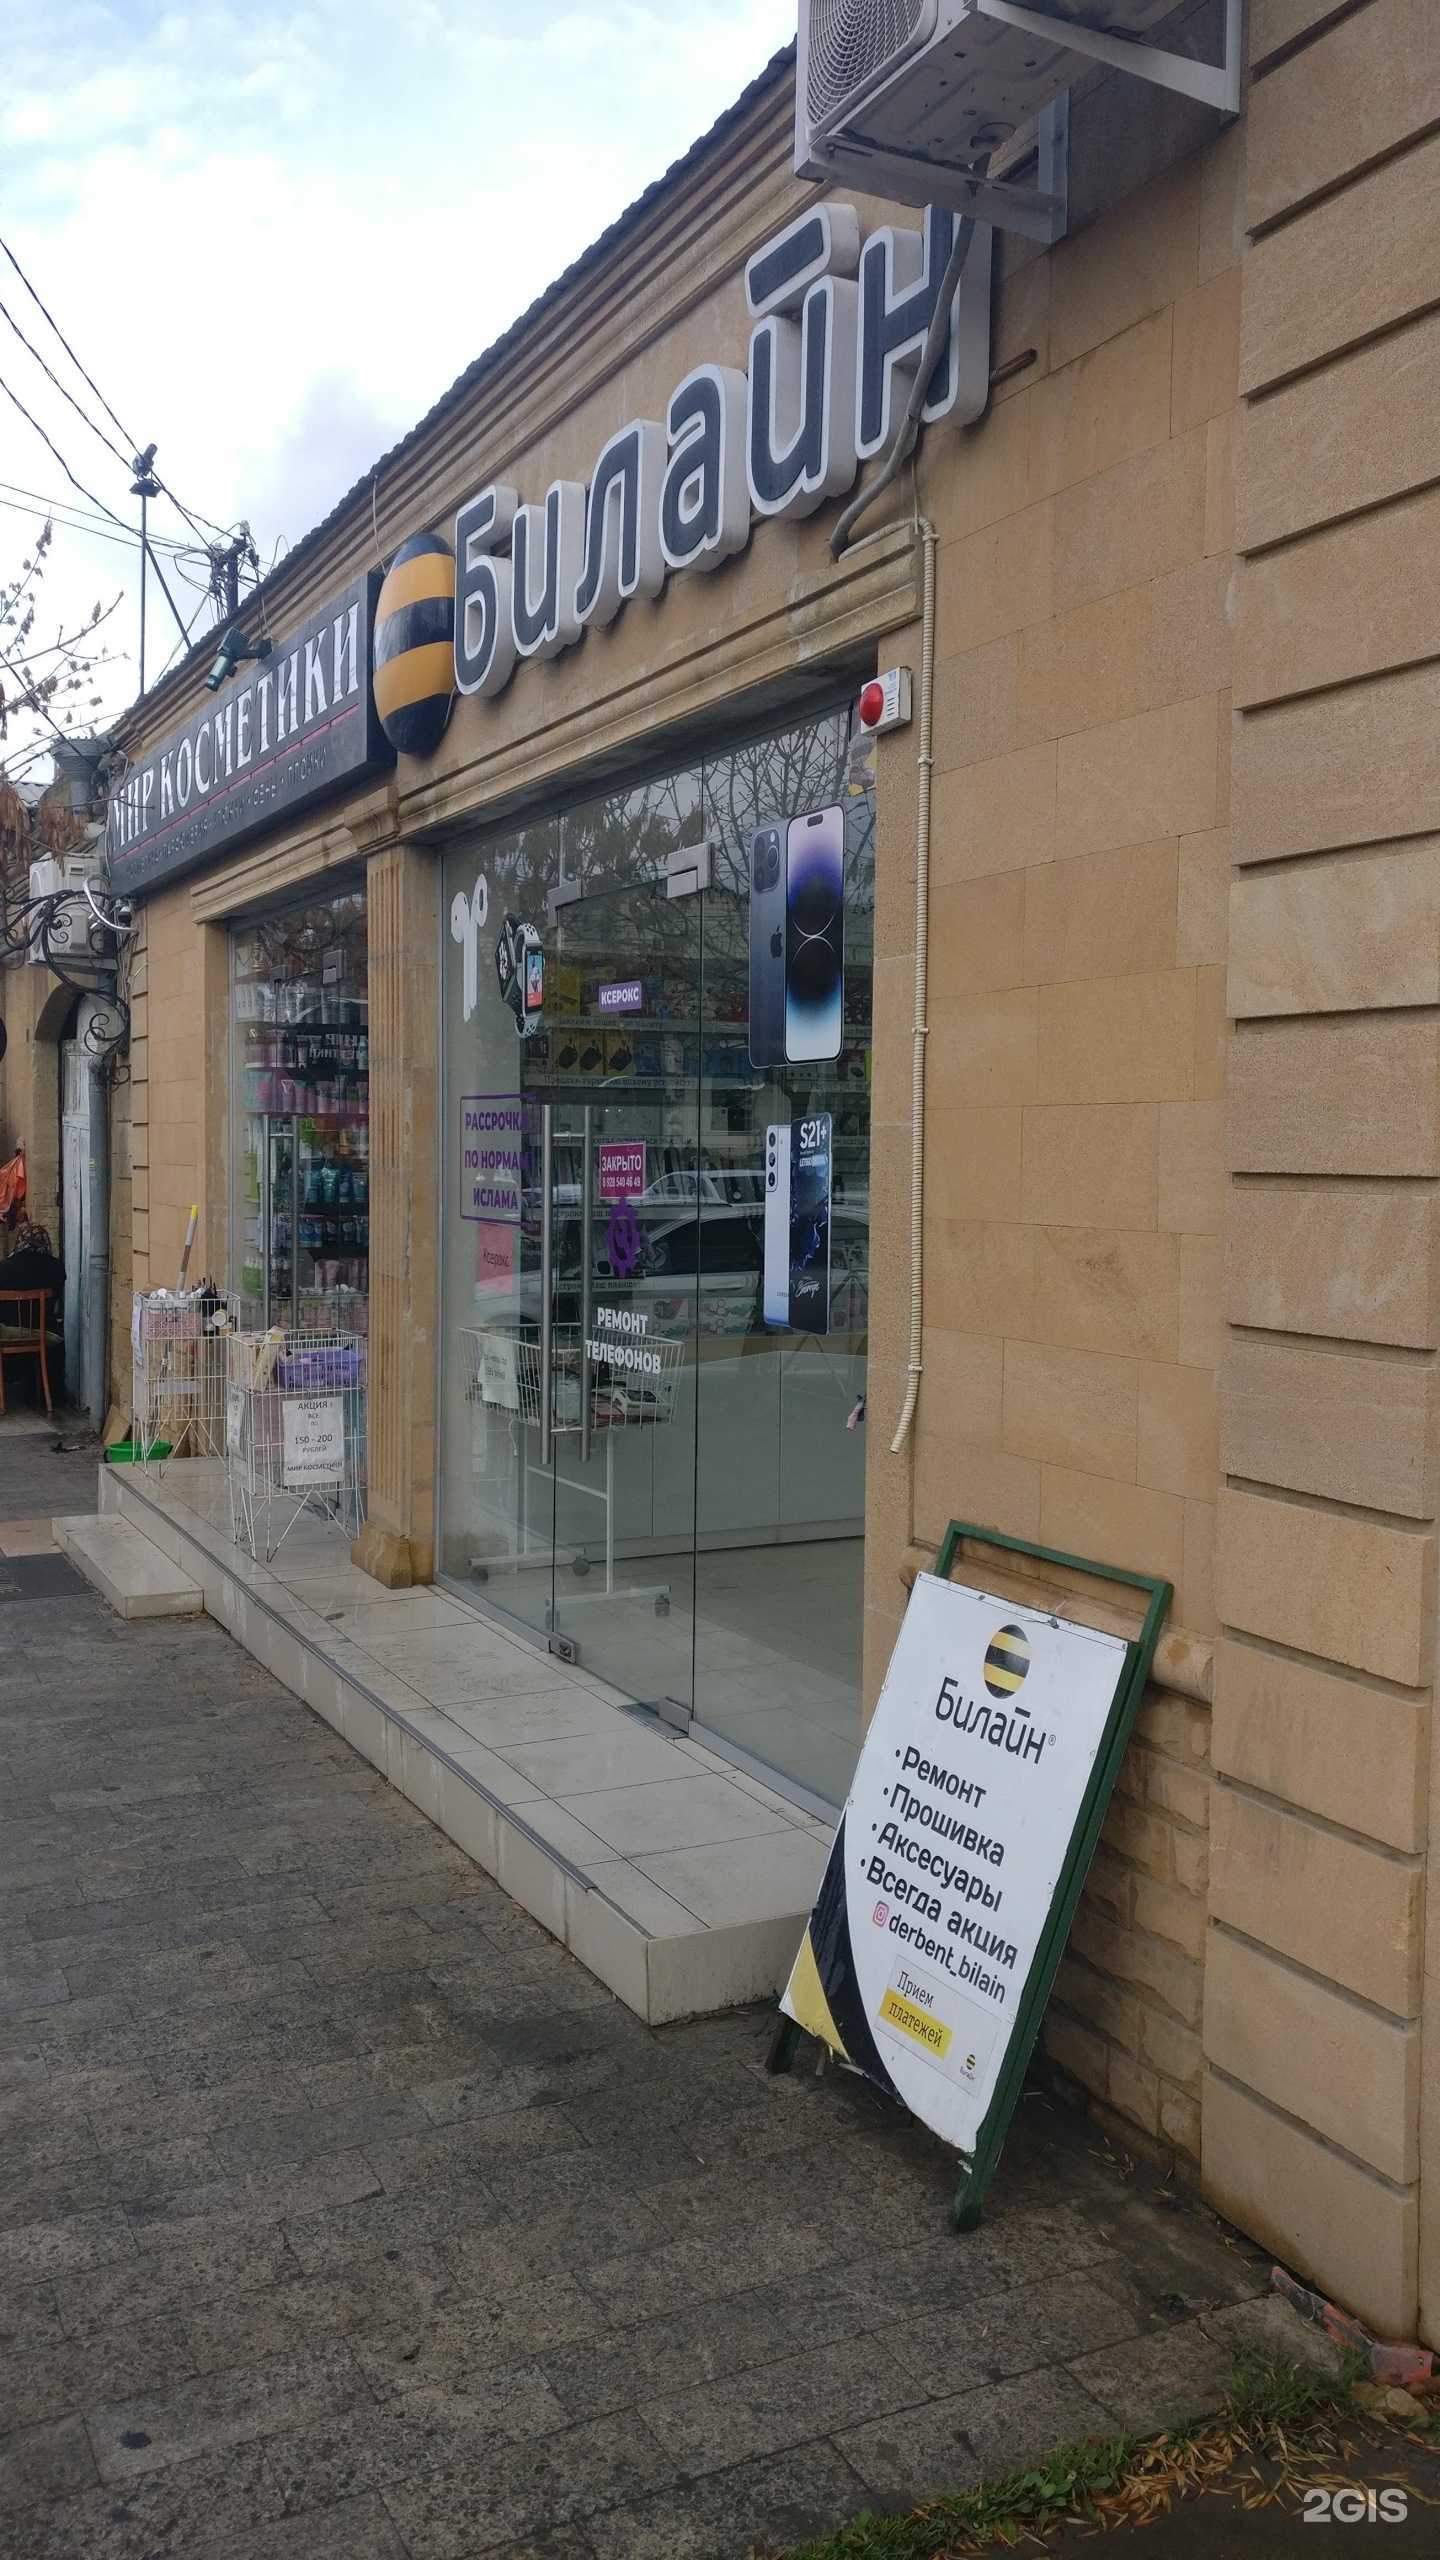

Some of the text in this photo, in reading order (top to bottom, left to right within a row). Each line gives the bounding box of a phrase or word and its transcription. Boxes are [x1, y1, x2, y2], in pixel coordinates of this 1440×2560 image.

[113, 768, 154, 847] МИР
[160, 601, 360, 820] КОСМЕТИКИ
[601, 987, 639, 1005] КСЕРОКС
[465, 1111, 529, 1131] РАССРОЧКА
[800, 1120, 827, 1150] S21+
[465, 1150, 478, 1169] ПО
[602, 1154, 642, 1172] ЗАКРЫТО
[473, 1188, 519, 1209] ИСЛАМА
[597, 1307, 648, 1335] РЕМОНТ
[585, 1340, 661, 1374] ТЕЛЕФОНОВ
[298, 1401, 328, 1411] АКЦИЯ
[935, 1676, 1047, 1765] Билайн
[902, 1746, 987, 1809] Ремонт
[889, 1783, 1005, 1867] Прошивка
[877, 1822, 1003, 1913] Аксесуары
[867, 1855, 1018, 1970] Всегда акция
[889, 1914, 1006, 2004] derbent_bilain
[897, 1971, 935, 2008] Прием
[888, 2002, 943, 2048] платежей
